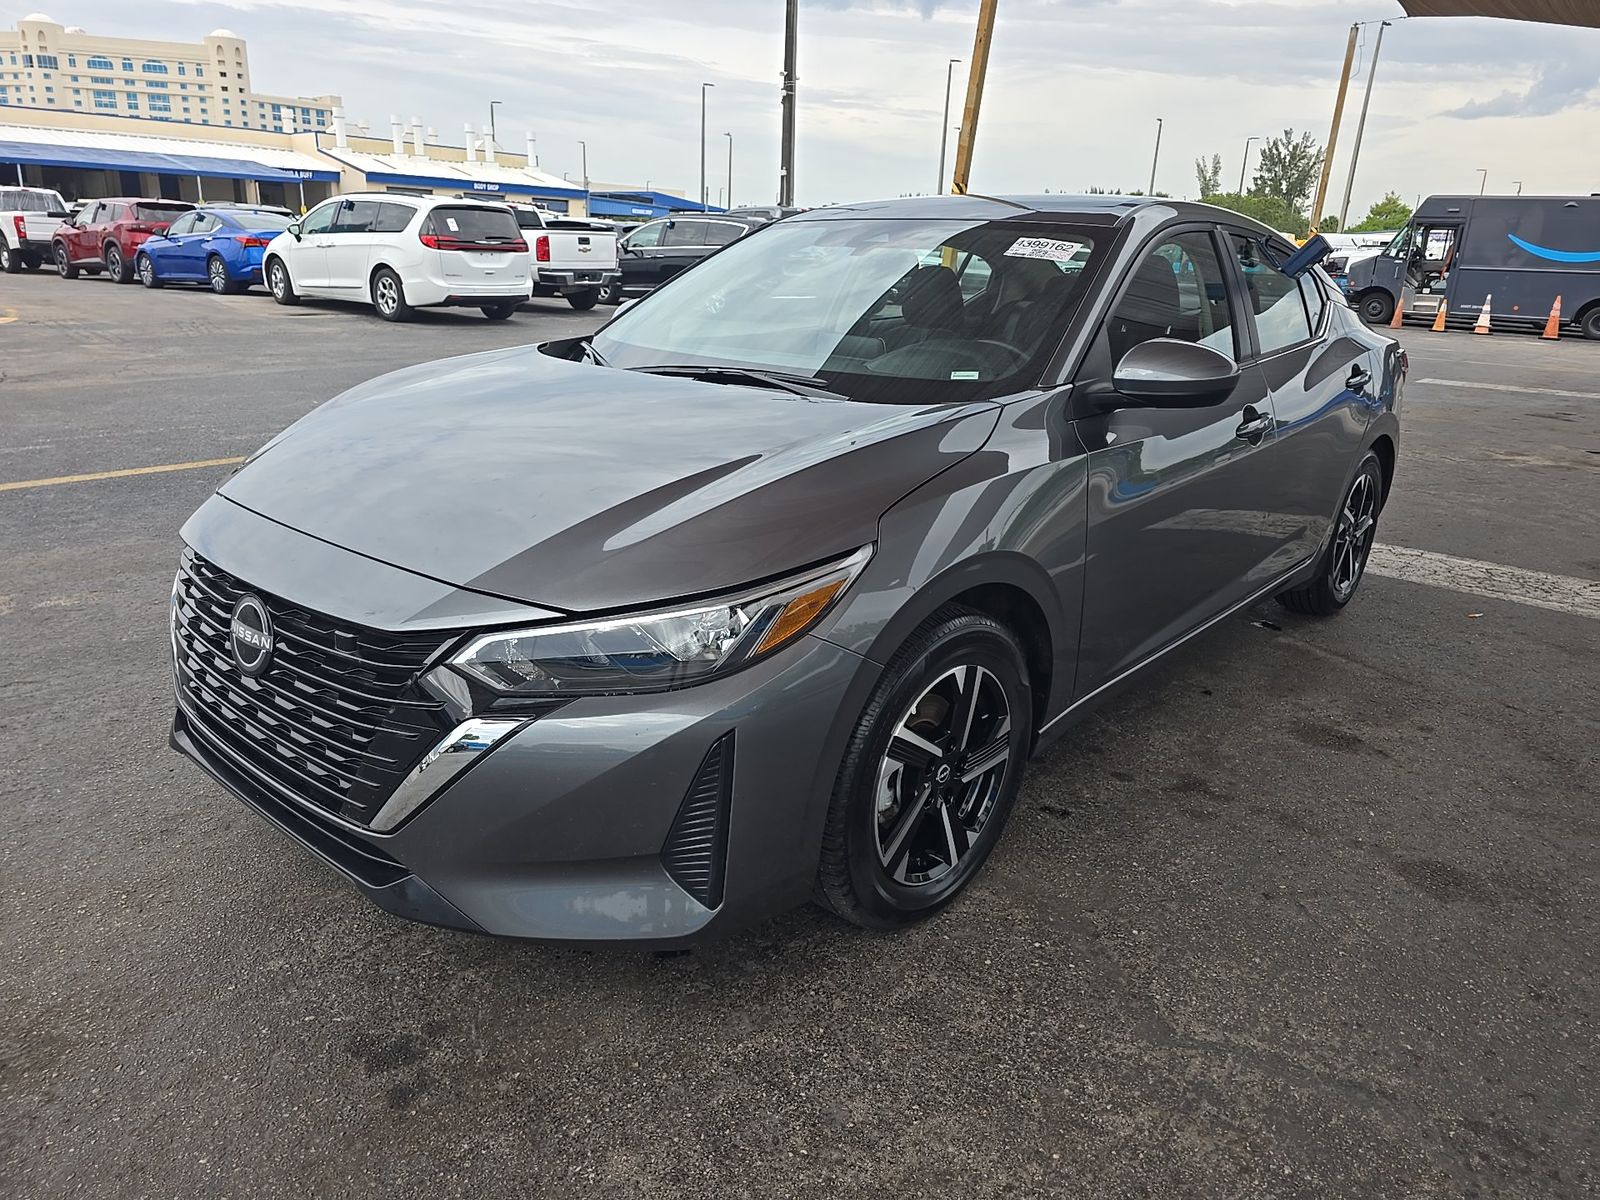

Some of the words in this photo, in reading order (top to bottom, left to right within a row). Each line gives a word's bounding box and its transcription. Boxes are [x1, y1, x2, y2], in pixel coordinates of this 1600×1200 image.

[473, 182, 486, 190] BODY
[487, 183, 500, 191] SHOP
[1015, 239, 1074, 253] 4399162
[231, 619, 270, 649] NISSAN
